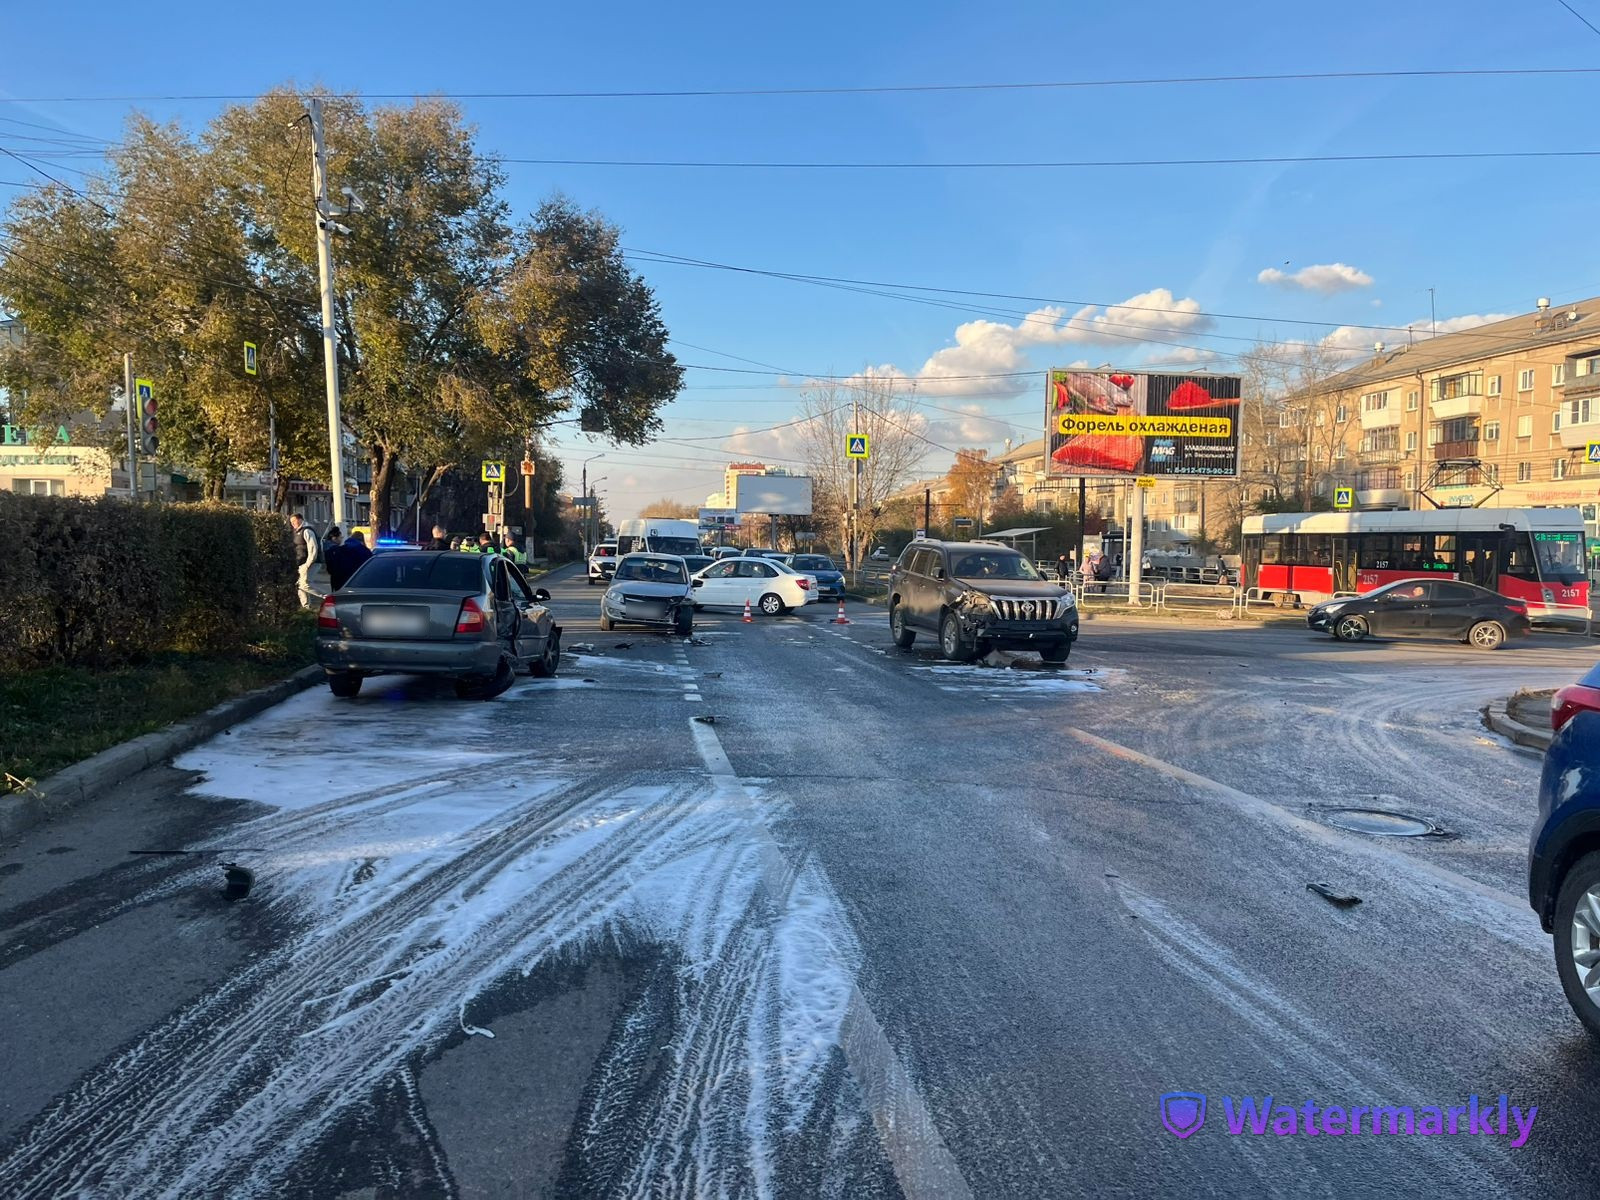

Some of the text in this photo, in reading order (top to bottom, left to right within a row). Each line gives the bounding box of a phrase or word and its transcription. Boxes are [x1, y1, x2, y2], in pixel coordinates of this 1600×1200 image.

[1062, 417, 1228, 435] Форель охлажденая
[1376, 560, 1389, 569] 2157
[1362, 574, 1379, 585] 2157
[1561, 589, 1580, 598] 2157
